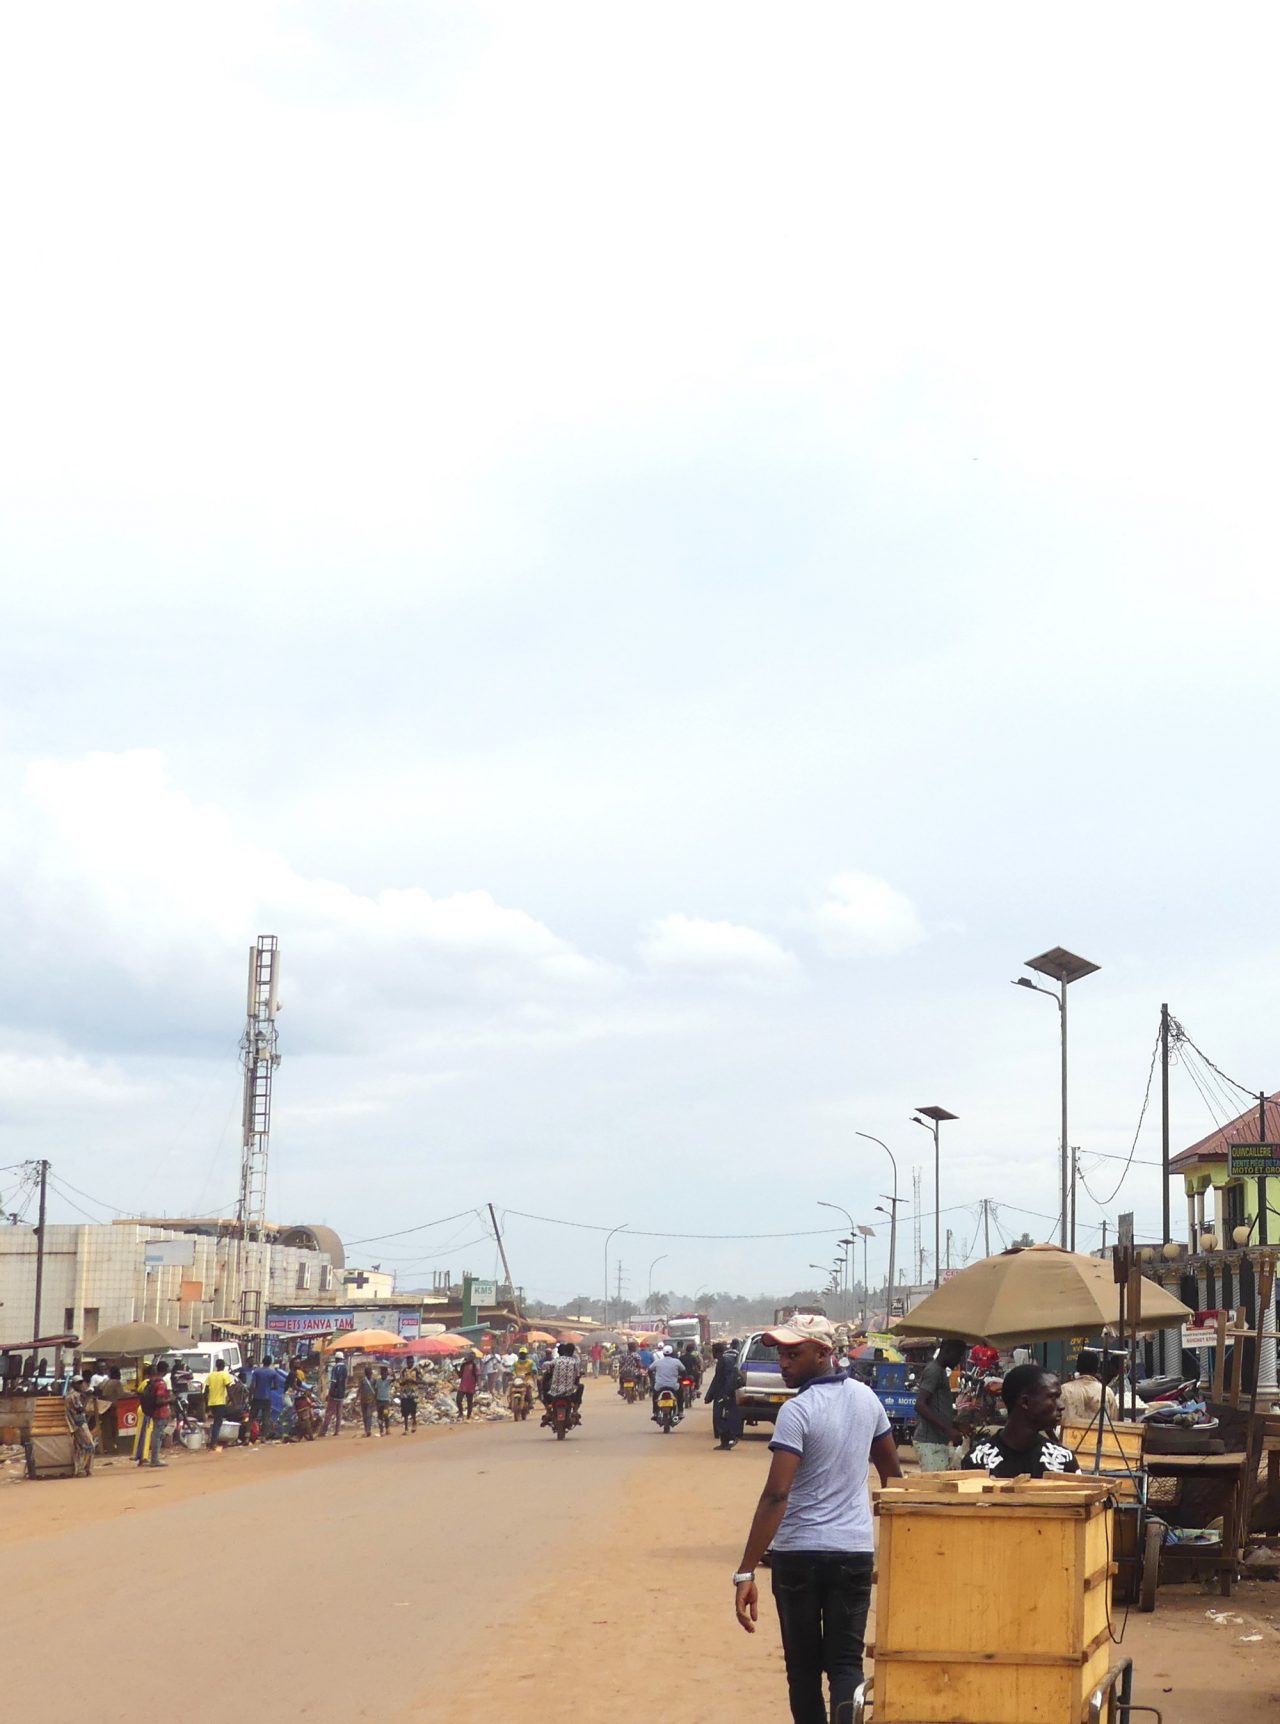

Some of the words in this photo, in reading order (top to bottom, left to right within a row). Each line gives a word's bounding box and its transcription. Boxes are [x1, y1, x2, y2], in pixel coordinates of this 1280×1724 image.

[1232, 1166, 1254, 1174] MOTO
[287, 1320, 300, 1330] ETS
[303, 1319, 332, 1329] SANYA
